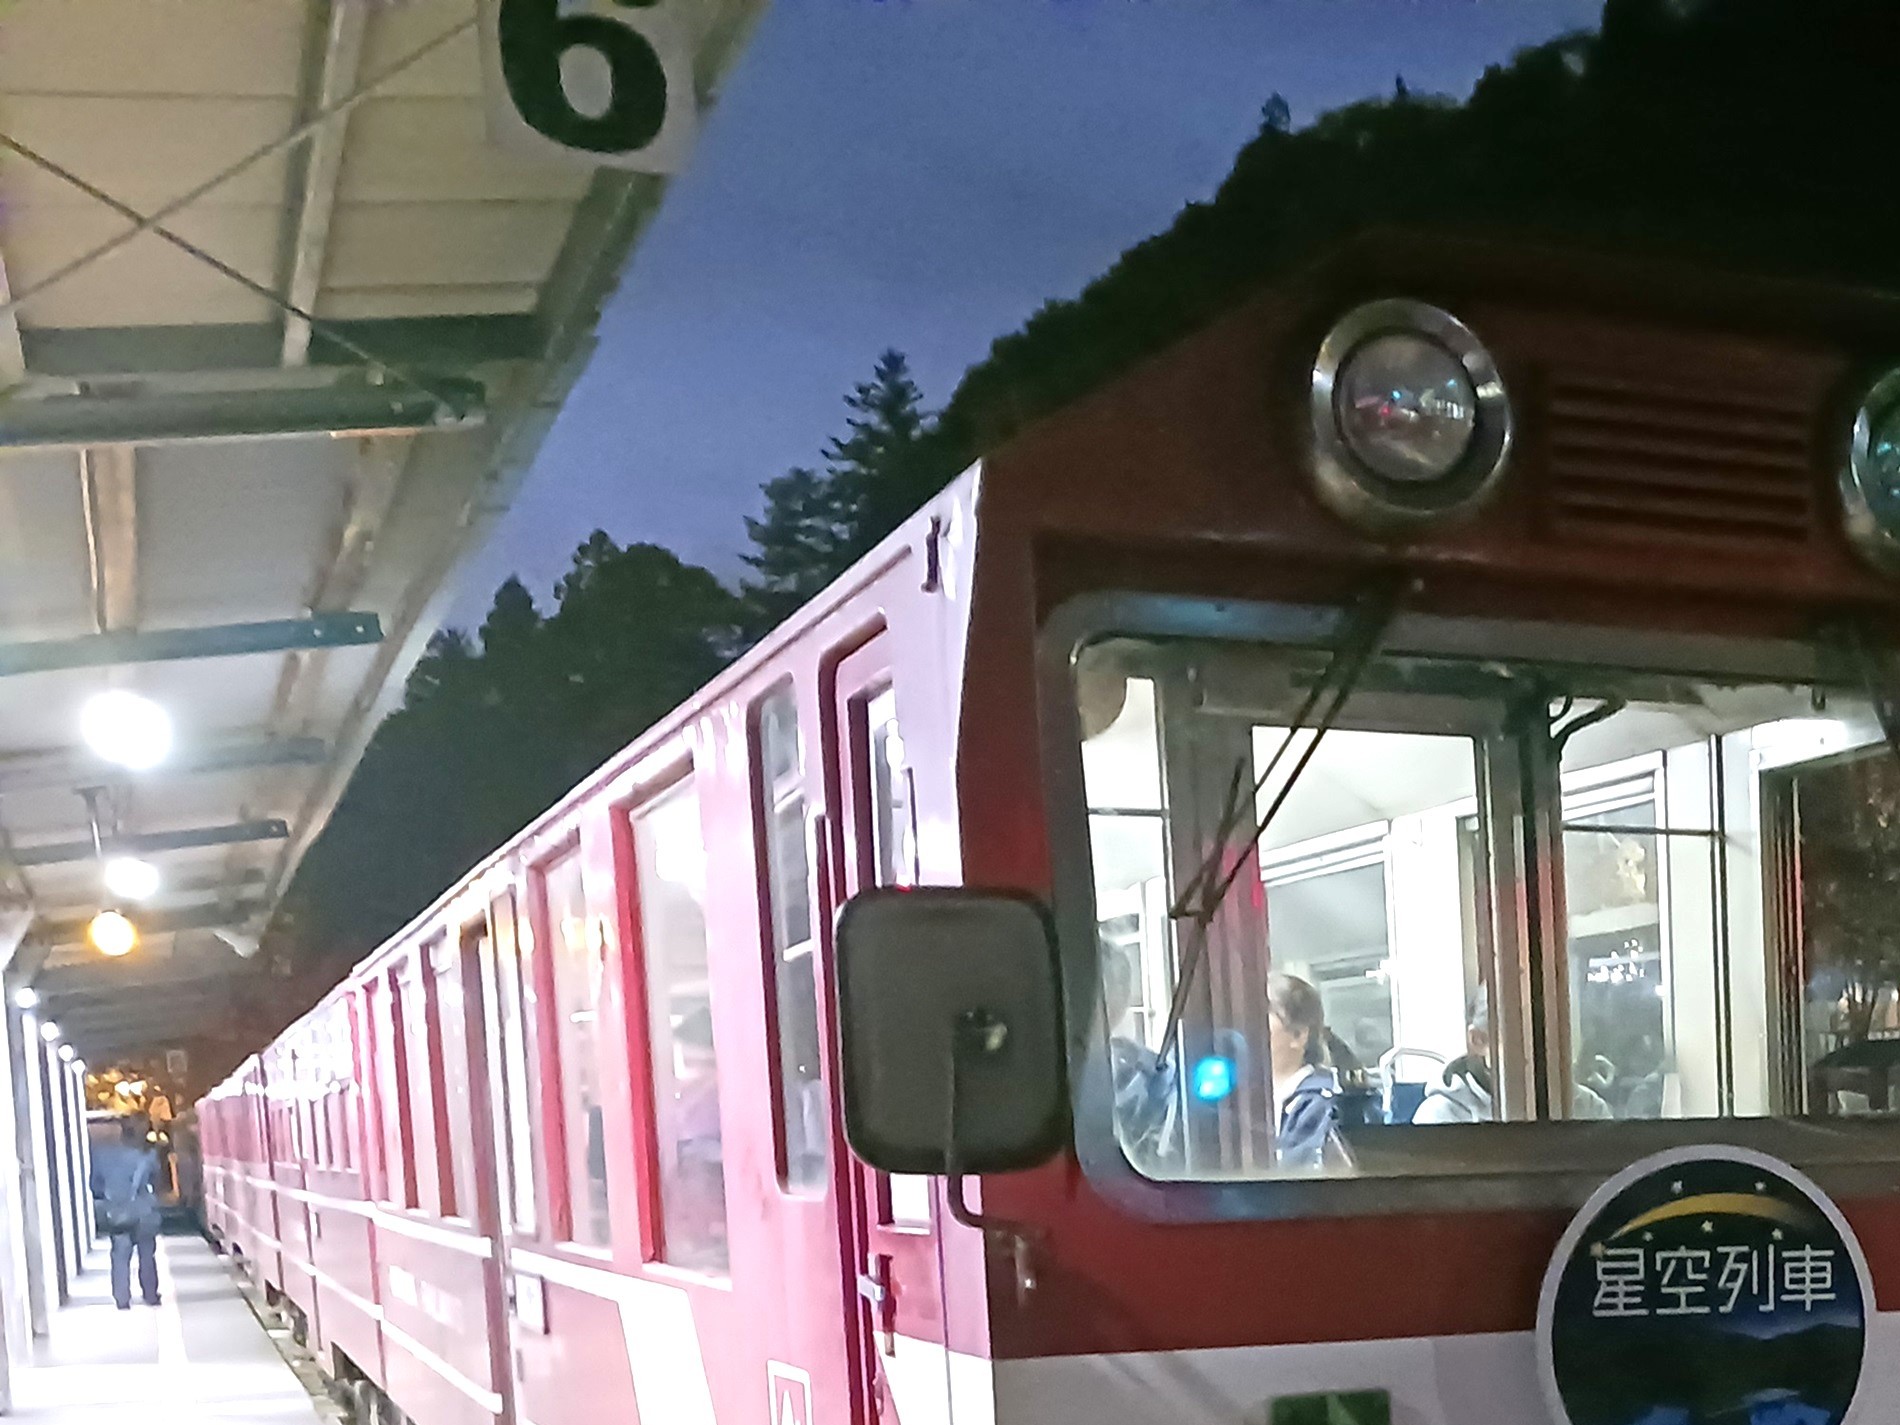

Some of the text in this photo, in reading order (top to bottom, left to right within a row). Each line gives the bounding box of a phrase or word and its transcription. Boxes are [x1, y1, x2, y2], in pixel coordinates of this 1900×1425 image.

[499, 0, 667, 153] 6
[1593, 1244, 1836, 1317] 星空列車
